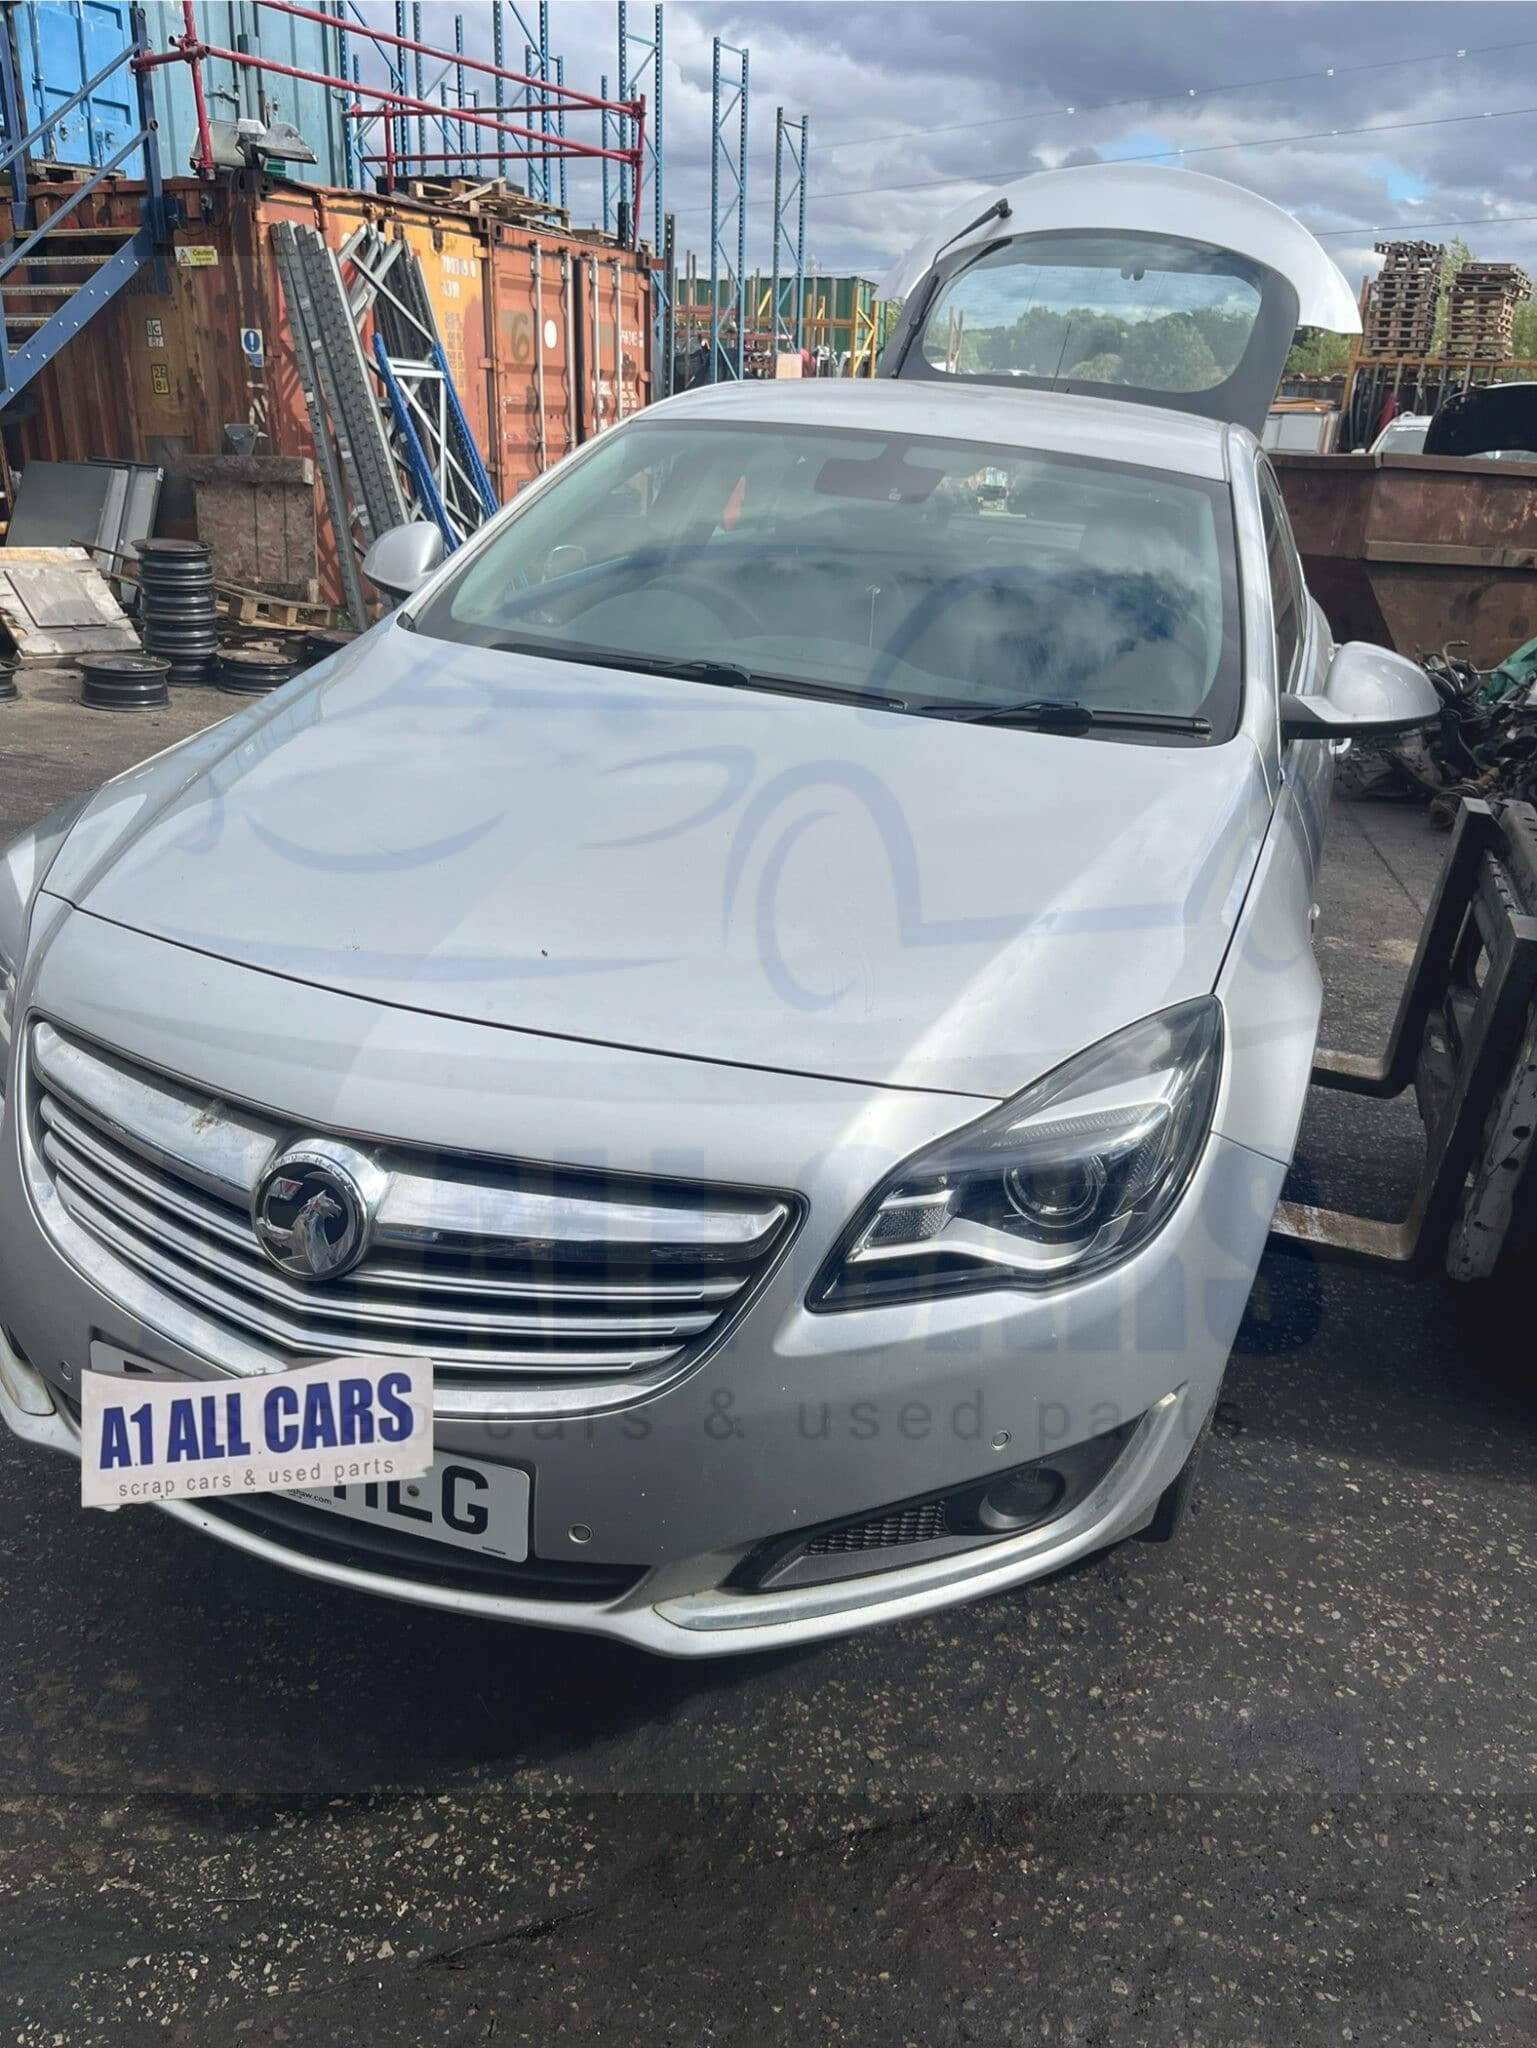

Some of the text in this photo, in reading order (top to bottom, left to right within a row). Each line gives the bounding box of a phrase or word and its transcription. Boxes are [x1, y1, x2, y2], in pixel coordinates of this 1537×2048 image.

[99, 1372, 414, 1469] A1 ALL CARS
[118, 1457, 395, 1499] scrap cars & used parts
